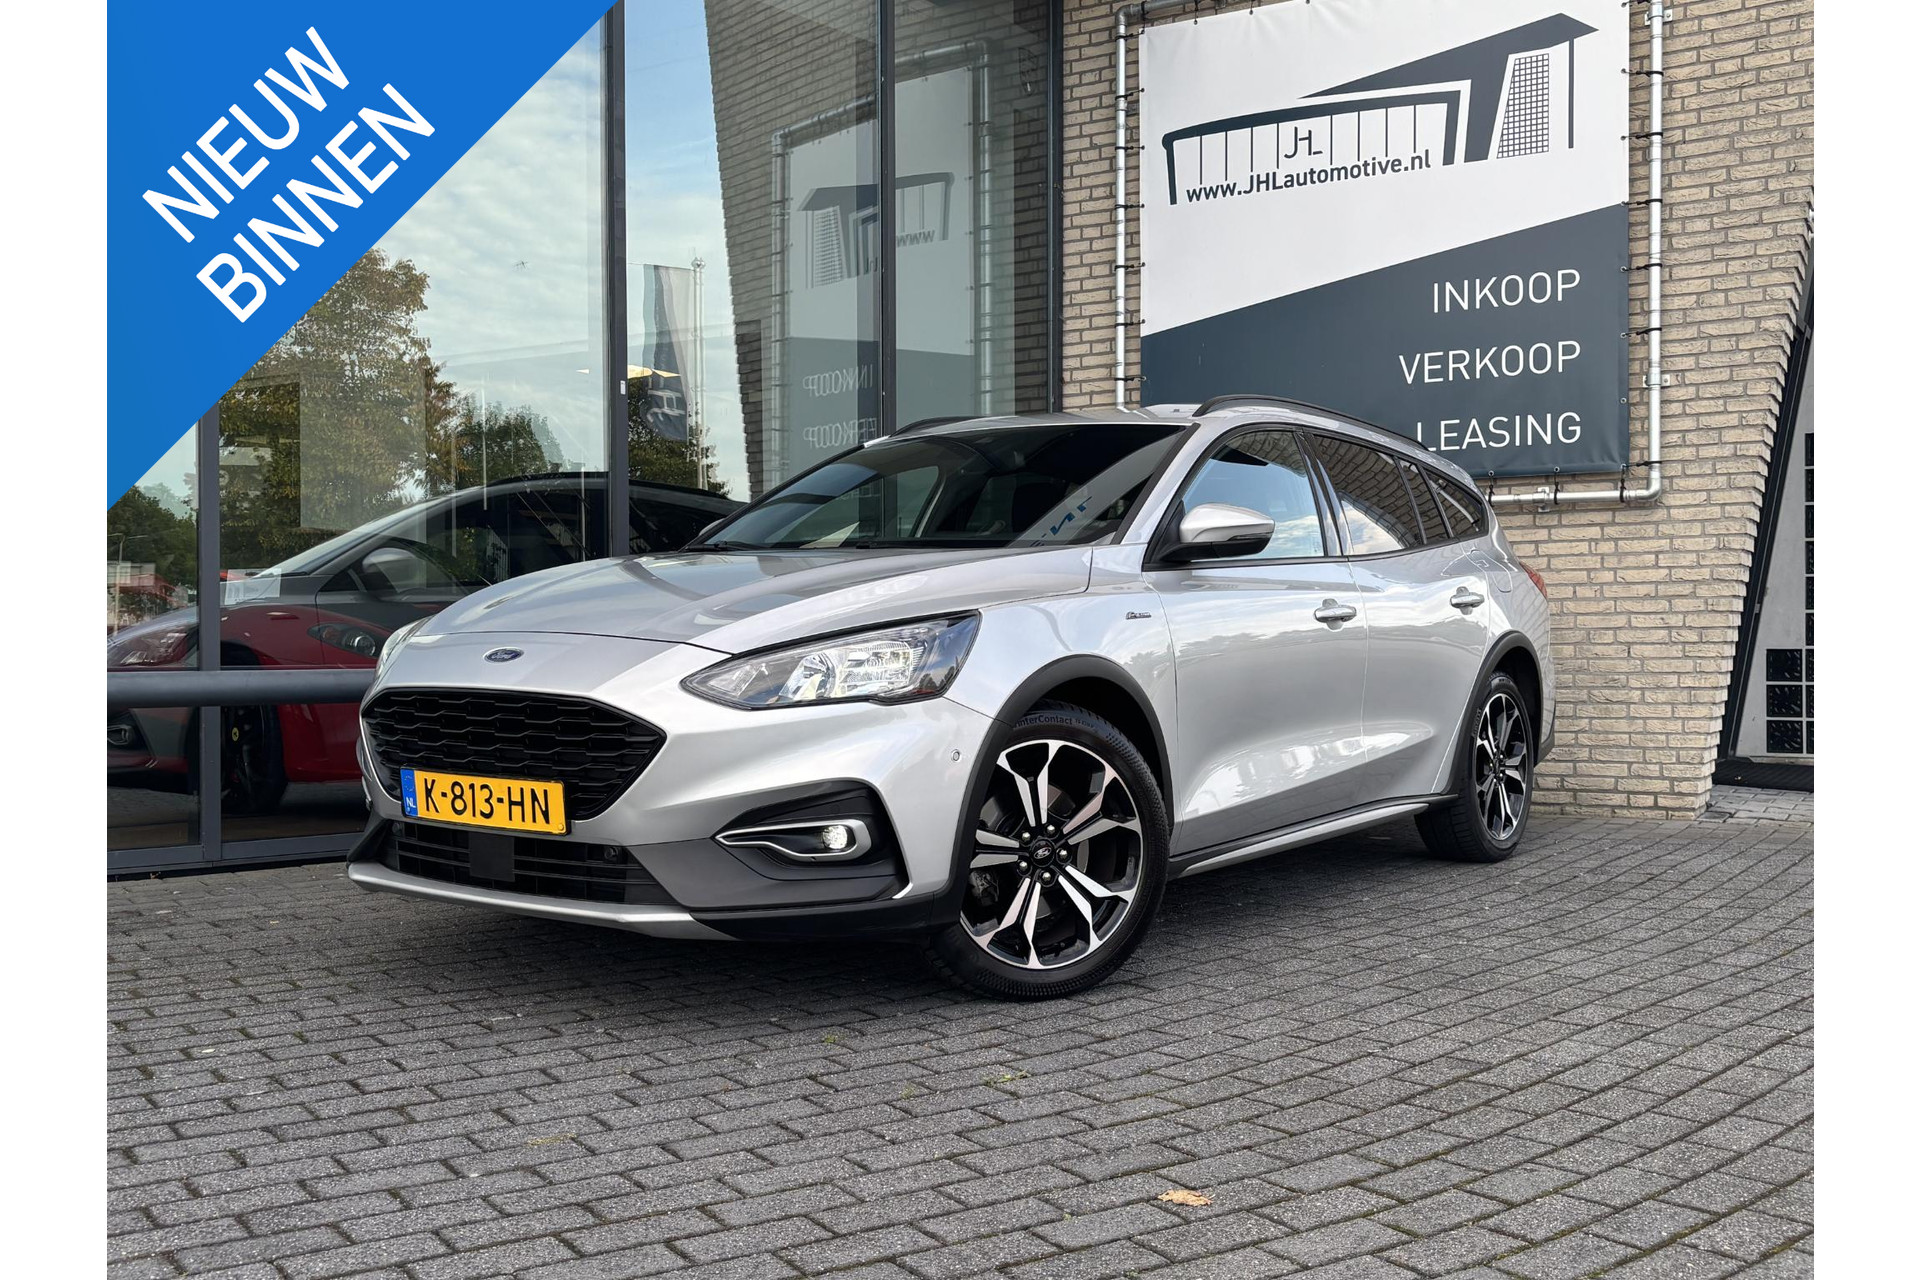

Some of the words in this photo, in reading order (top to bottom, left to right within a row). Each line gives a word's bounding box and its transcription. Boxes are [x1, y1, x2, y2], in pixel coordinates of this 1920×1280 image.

[1186, 149, 1431, 202] www.JHLautomotive.nl
[1432, 269, 1581, 313] INKOOP
[1398, 341, 1581, 384] VERKOOP
[1417, 411, 1582, 452] LEASING
[405, 797, 416, 808] NL
[424, 778, 550, 824] K-813-HN
